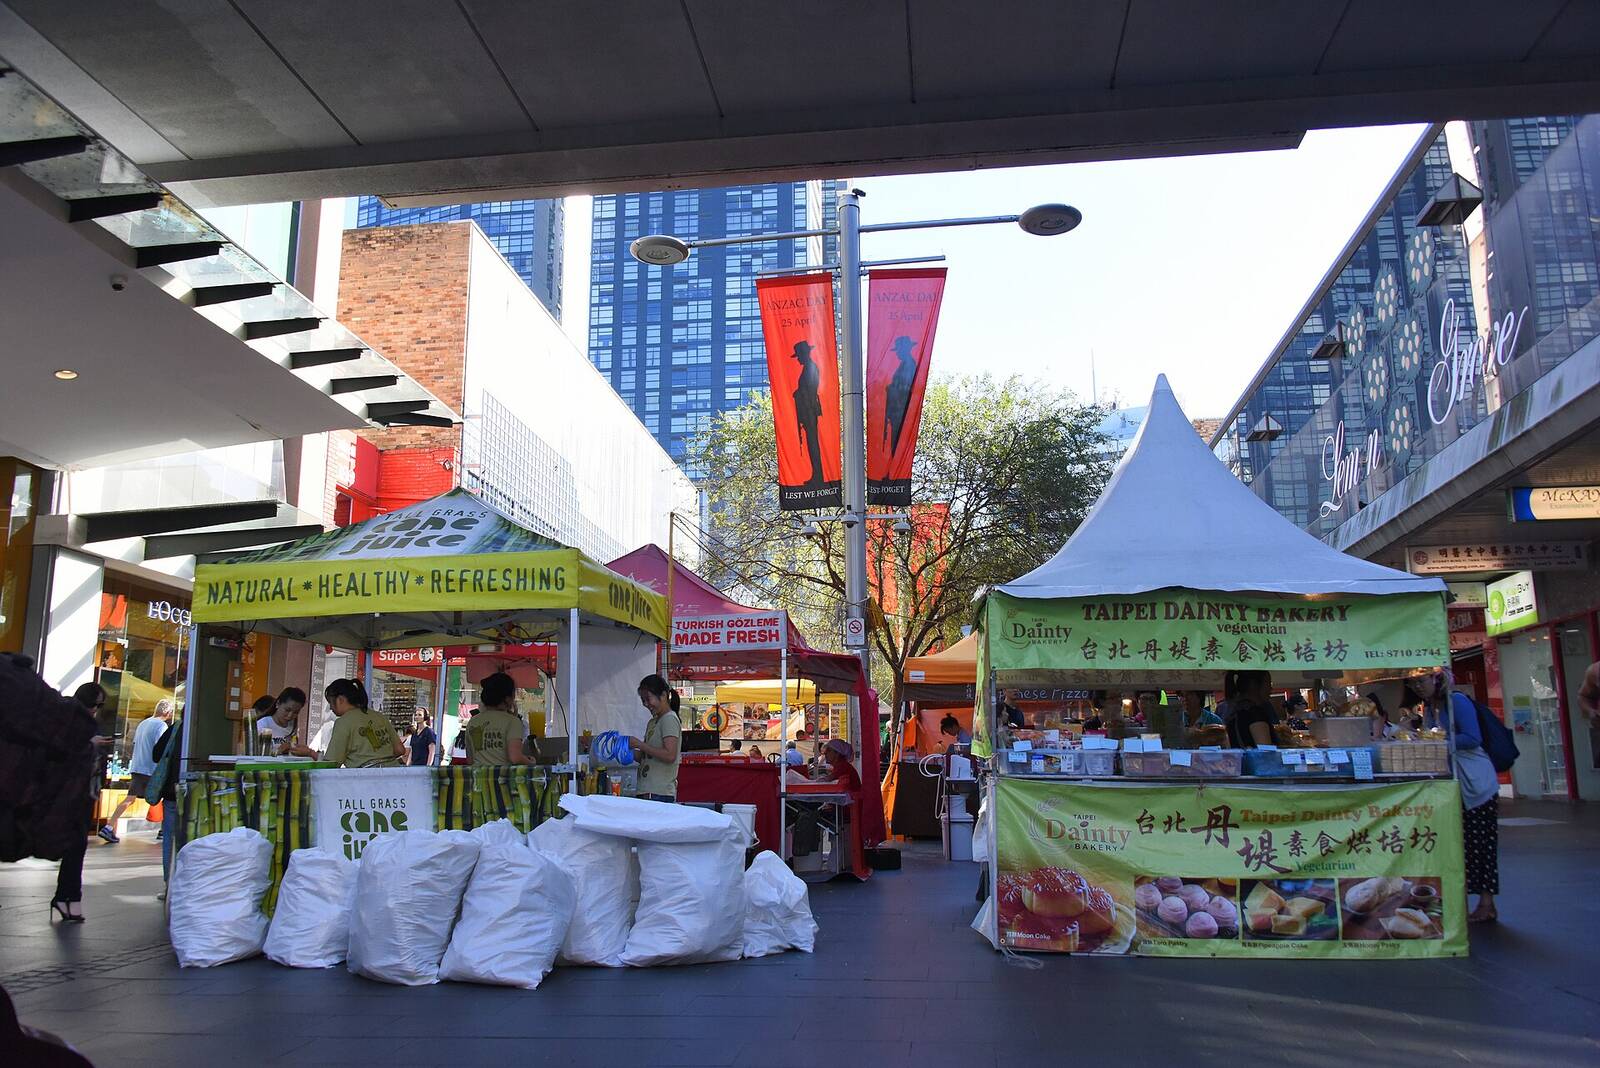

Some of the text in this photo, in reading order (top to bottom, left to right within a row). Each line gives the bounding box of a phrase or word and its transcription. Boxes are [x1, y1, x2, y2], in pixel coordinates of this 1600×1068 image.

[766, 297, 804, 311] ANZAC
[781, 315, 817, 328] 25 April
[785, 491, 803, 500] LEST
[804, 489, 816, 498] WE
[384, 508, 489, 521] TALL GRASS
[372, 517, 480, 533] cane
[339, 530, 467, 556] juice
[207, 566, 566, 605] NATURAL HEALTHY REFRESHING
[1082, 602, 1352, 623] TAIPEI DAINTY BAKERY
[675, 617, 780, 631] TURKISH GÖZLEME
[1216, 624, 1287, 636] vegetarian
[674, 629, 780, 646] MADE FRESH
[1012, 623, 1072, 643] Dainty
[379, 650, 417, 664] Super
[1365, 650, 1384, 659] TEL:
[338, 798, 406, 810] TALL GRASS
[1239, 802, 1435, 825] Taipei Dainty Bakery
[340, 810, 409, 833] cane
[1046, 819, 1133, 851] Dainty
[1074, 843, 1118, 853] BAKERY
[1297, 859, 1356, 873] Vegetarian
[1017, 931, 1034, 939] Moon
